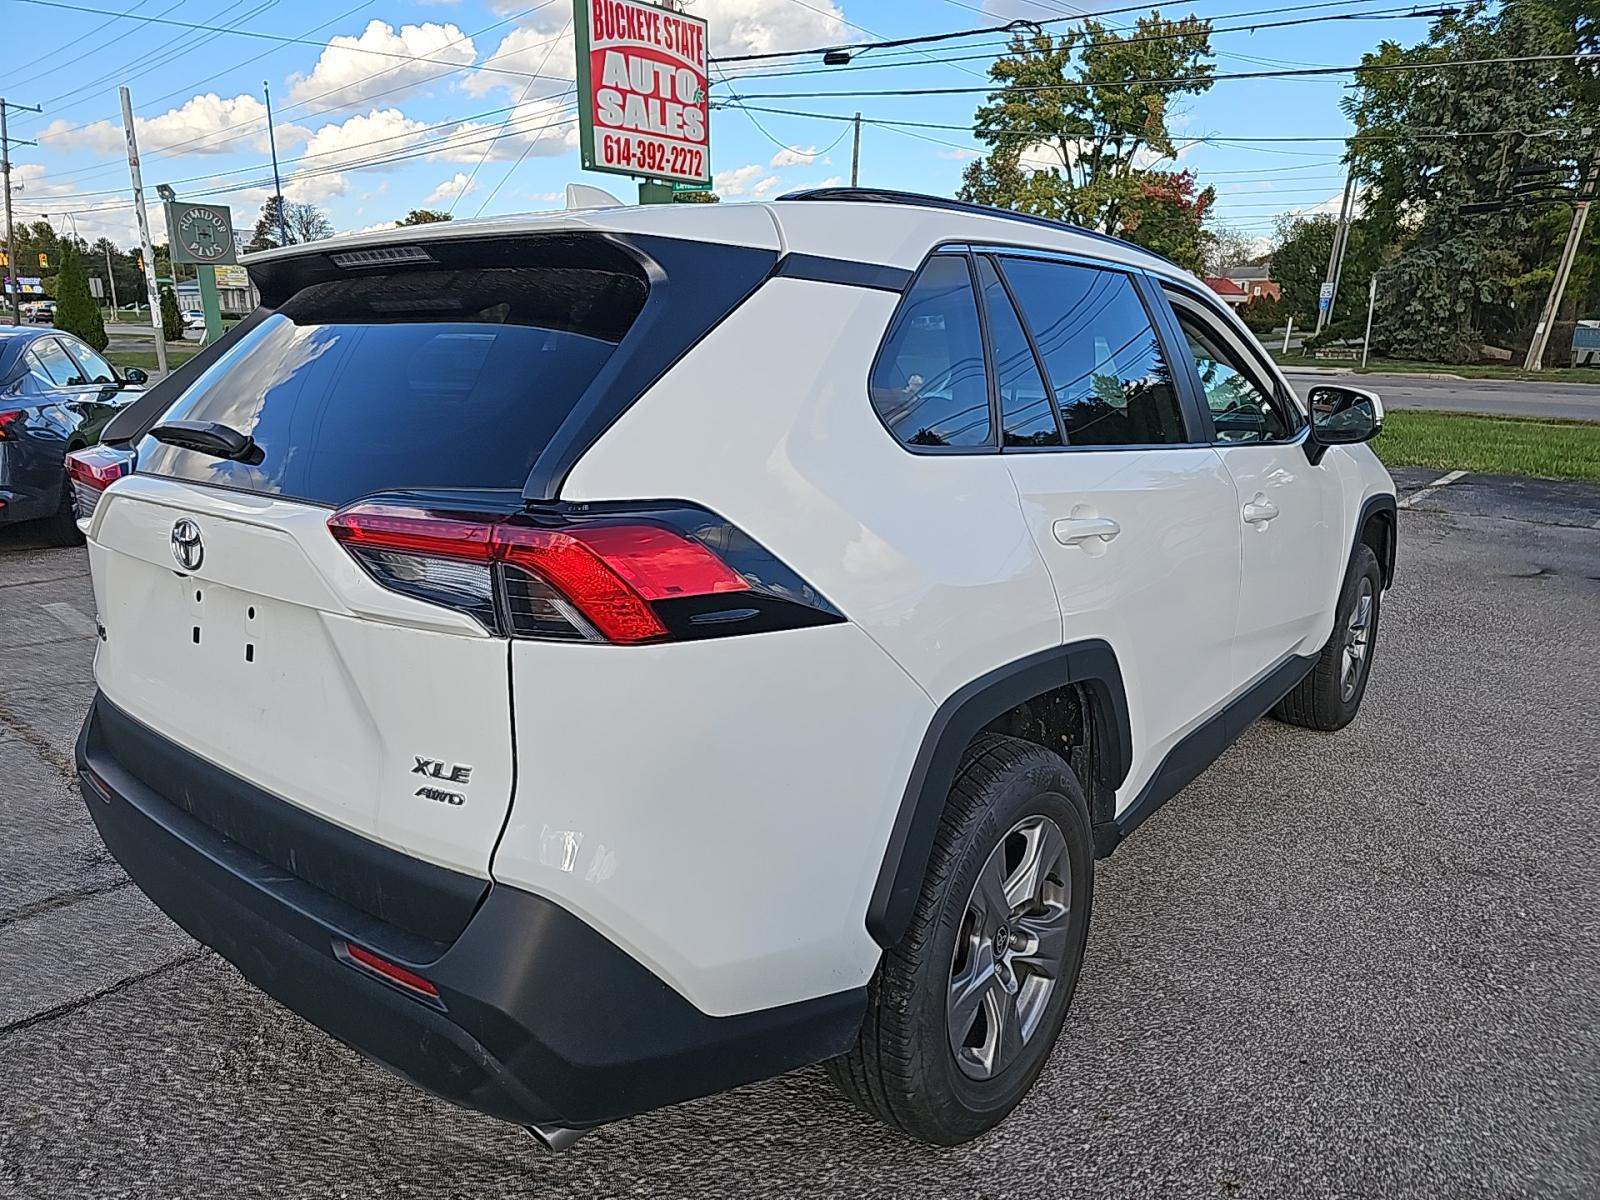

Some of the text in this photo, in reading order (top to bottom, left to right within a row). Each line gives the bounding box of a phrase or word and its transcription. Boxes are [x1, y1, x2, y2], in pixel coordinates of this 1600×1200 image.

[592, 0, 704, 69] BUCKEYE STATE
[602, 50, 698, 104] AUTO
[597, 88, 705, 142] SALES
[603, 134, 703, 177] 614-392-2272
[180, 209, 227, 233] HUMIDOR
[189, 242, 223, 257] PLUS
[411, 755, 473, 784] XLE
[414, 786, 466, 806] AWD
